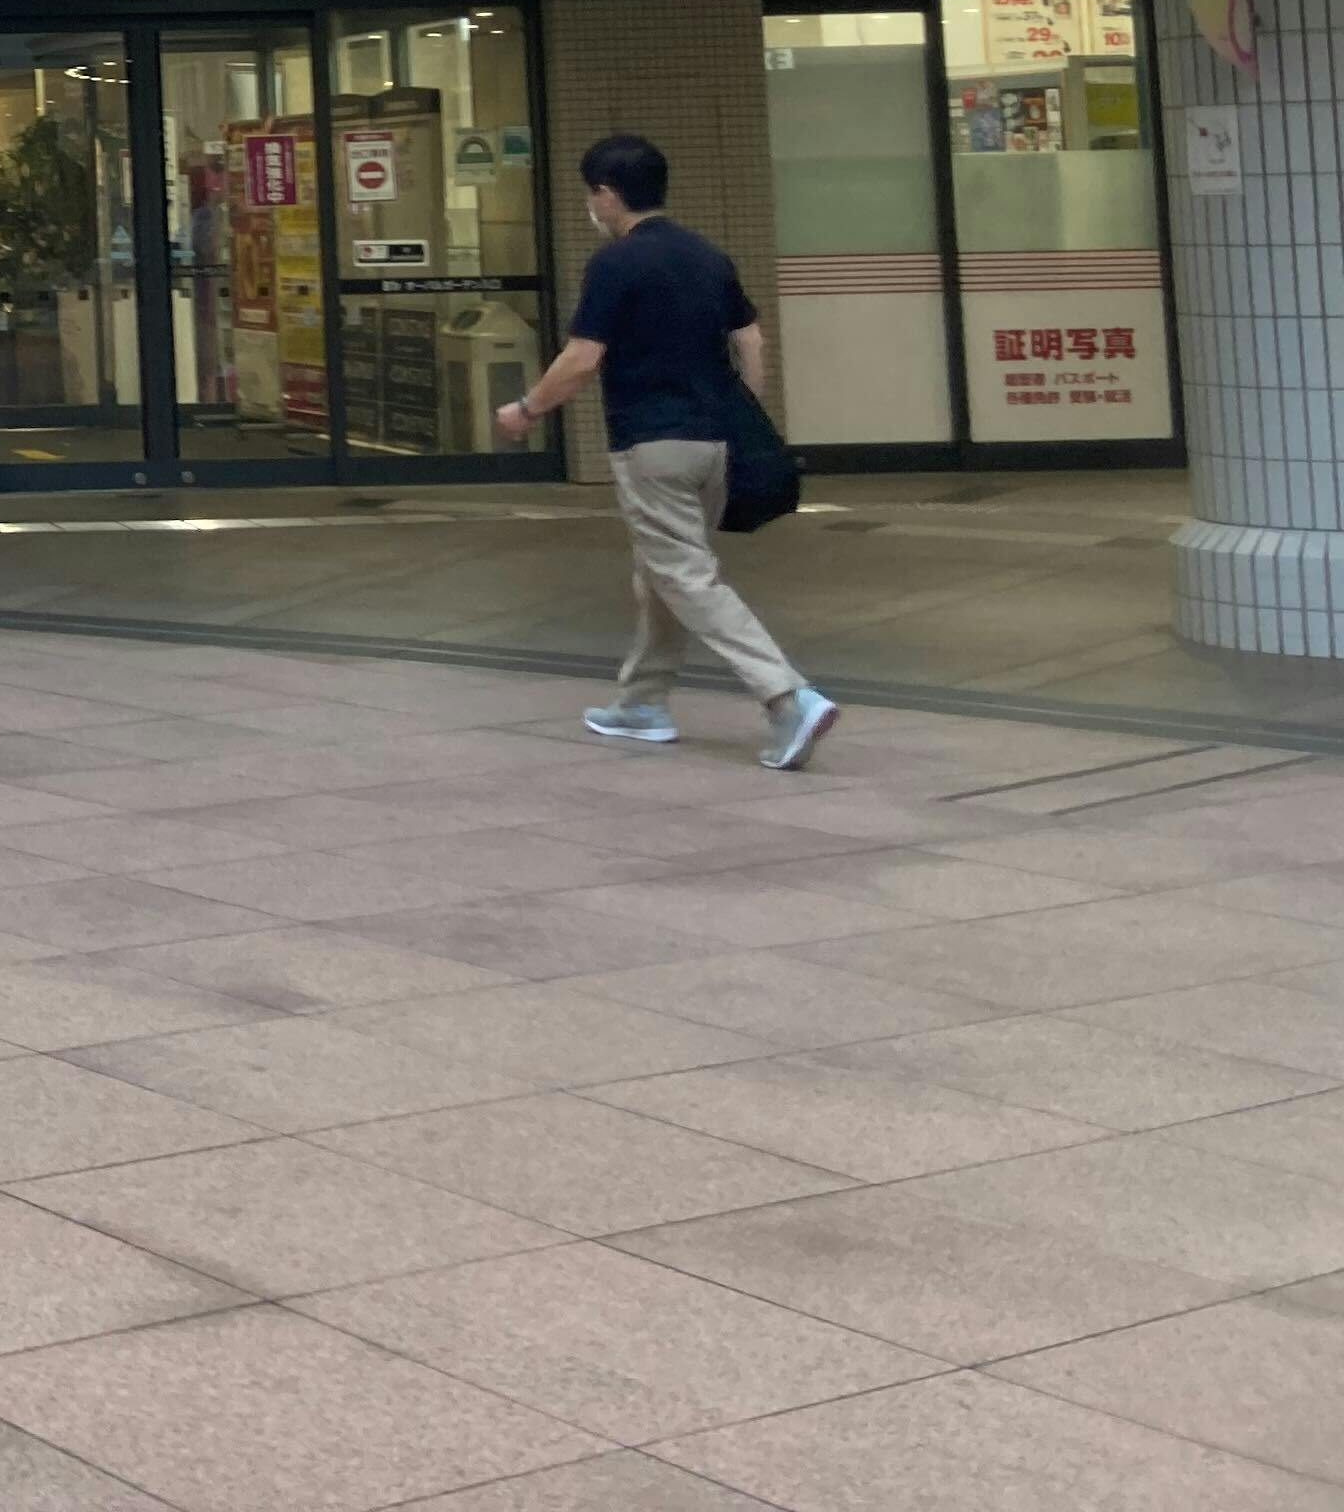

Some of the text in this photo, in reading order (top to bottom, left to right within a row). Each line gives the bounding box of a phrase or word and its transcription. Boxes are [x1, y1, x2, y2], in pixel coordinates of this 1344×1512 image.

[993, 328, 1137, 361] 証明写真
[1054, 371, 1120, 386] パスポート
